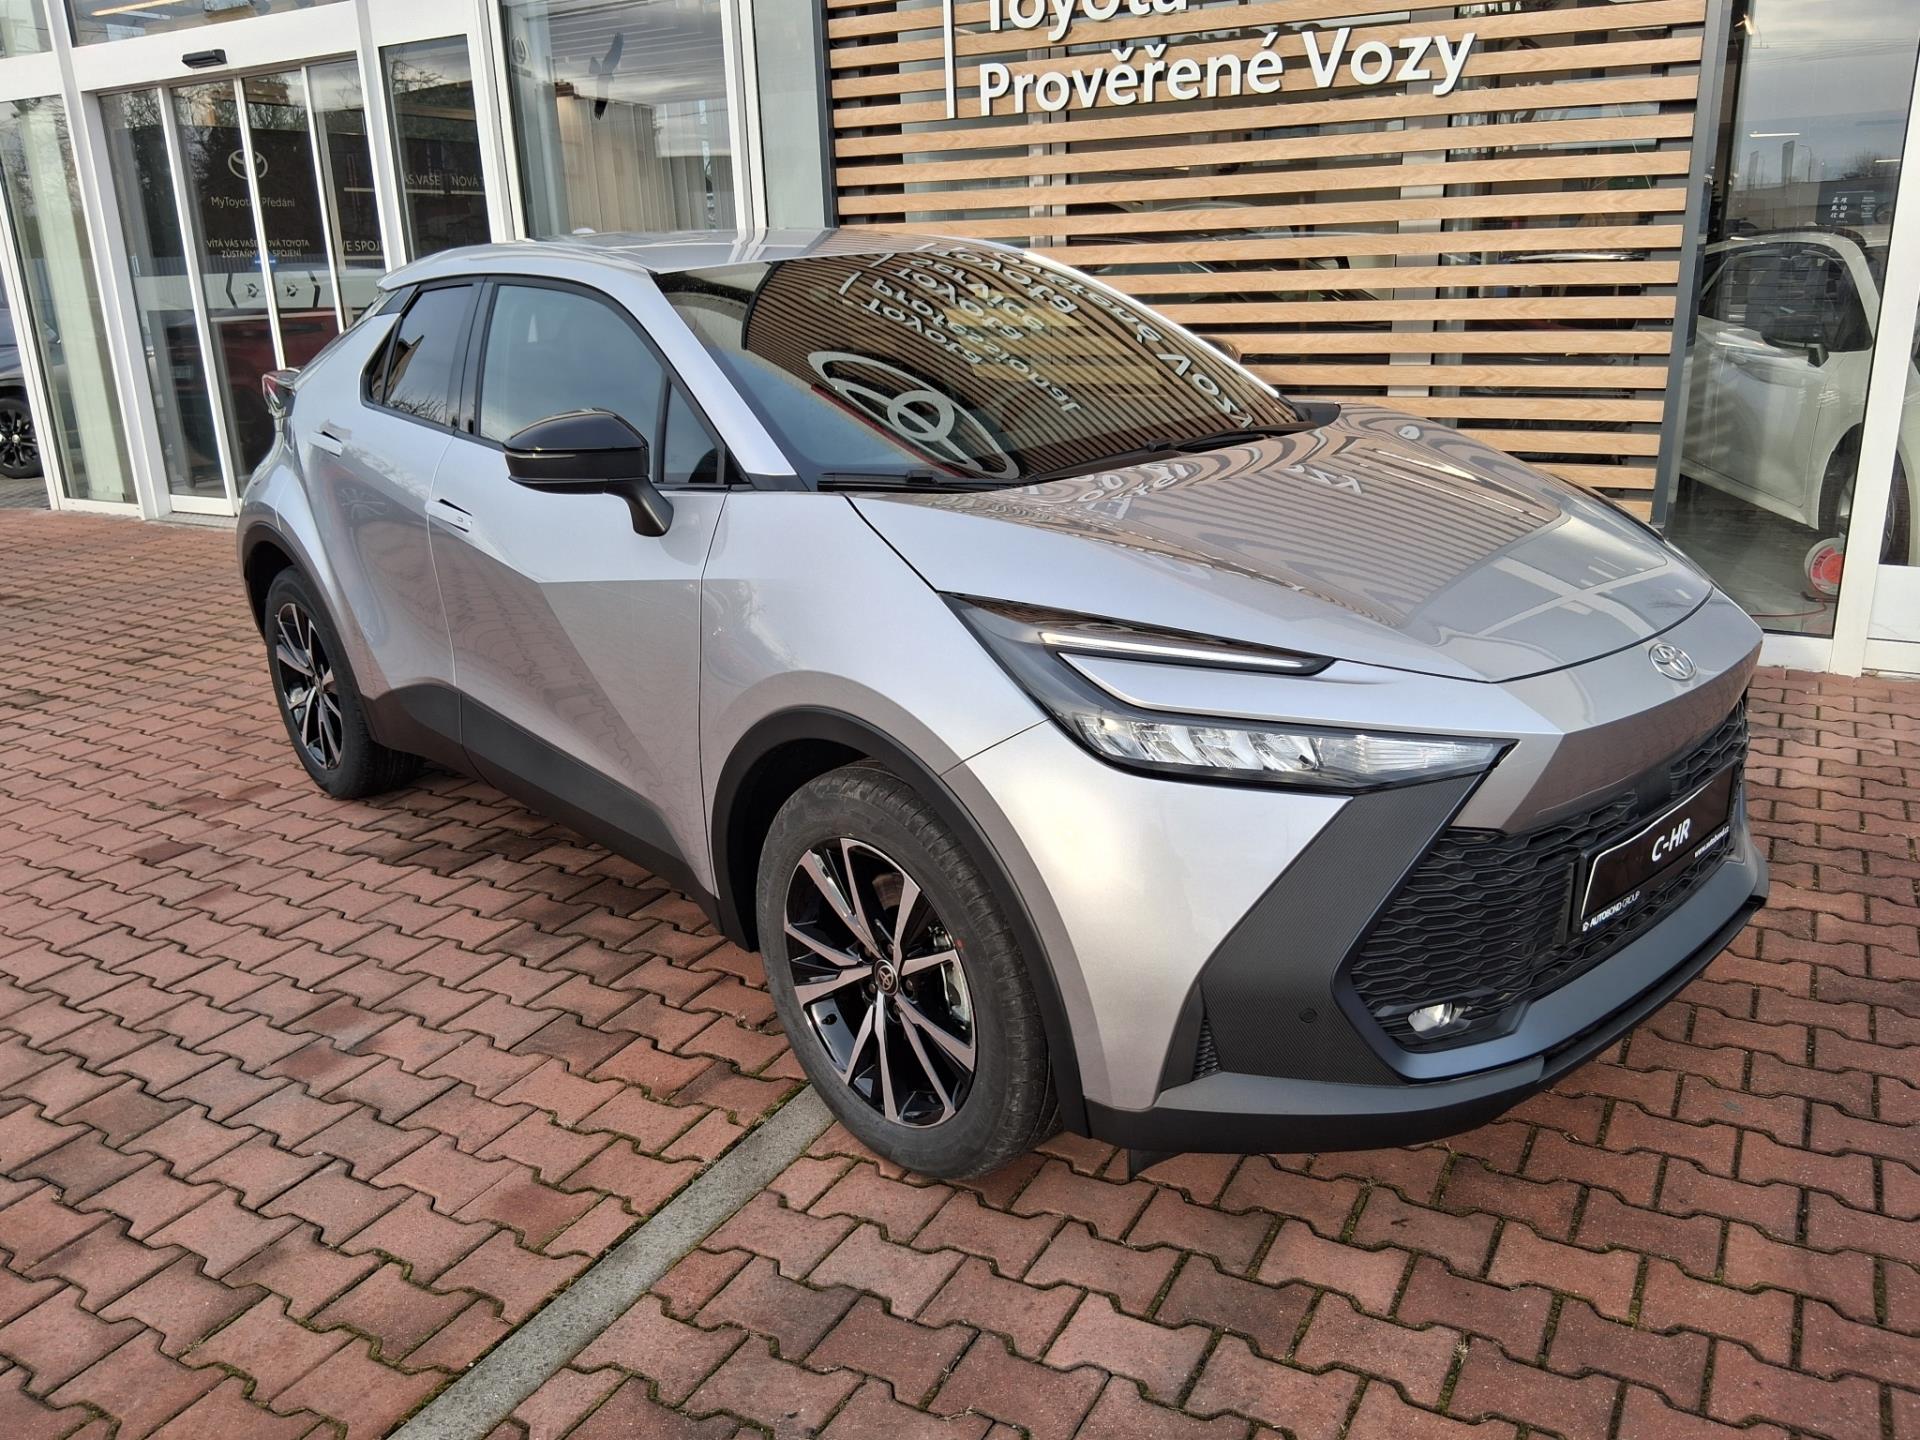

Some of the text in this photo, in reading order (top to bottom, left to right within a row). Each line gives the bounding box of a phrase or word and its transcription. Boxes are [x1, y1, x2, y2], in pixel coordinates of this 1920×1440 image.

[989, 0, 1187, 41] Toyo
[979, 27, 1478, 117] Prověřené Vozy
[210, 196, 252, 209] MyToyot
[281, 238, 310, 248] TOYOTA
[1651, 818, 1691, 862] C-HR
[1589, 890, 1641, 928] AUTOBOND GROUP
